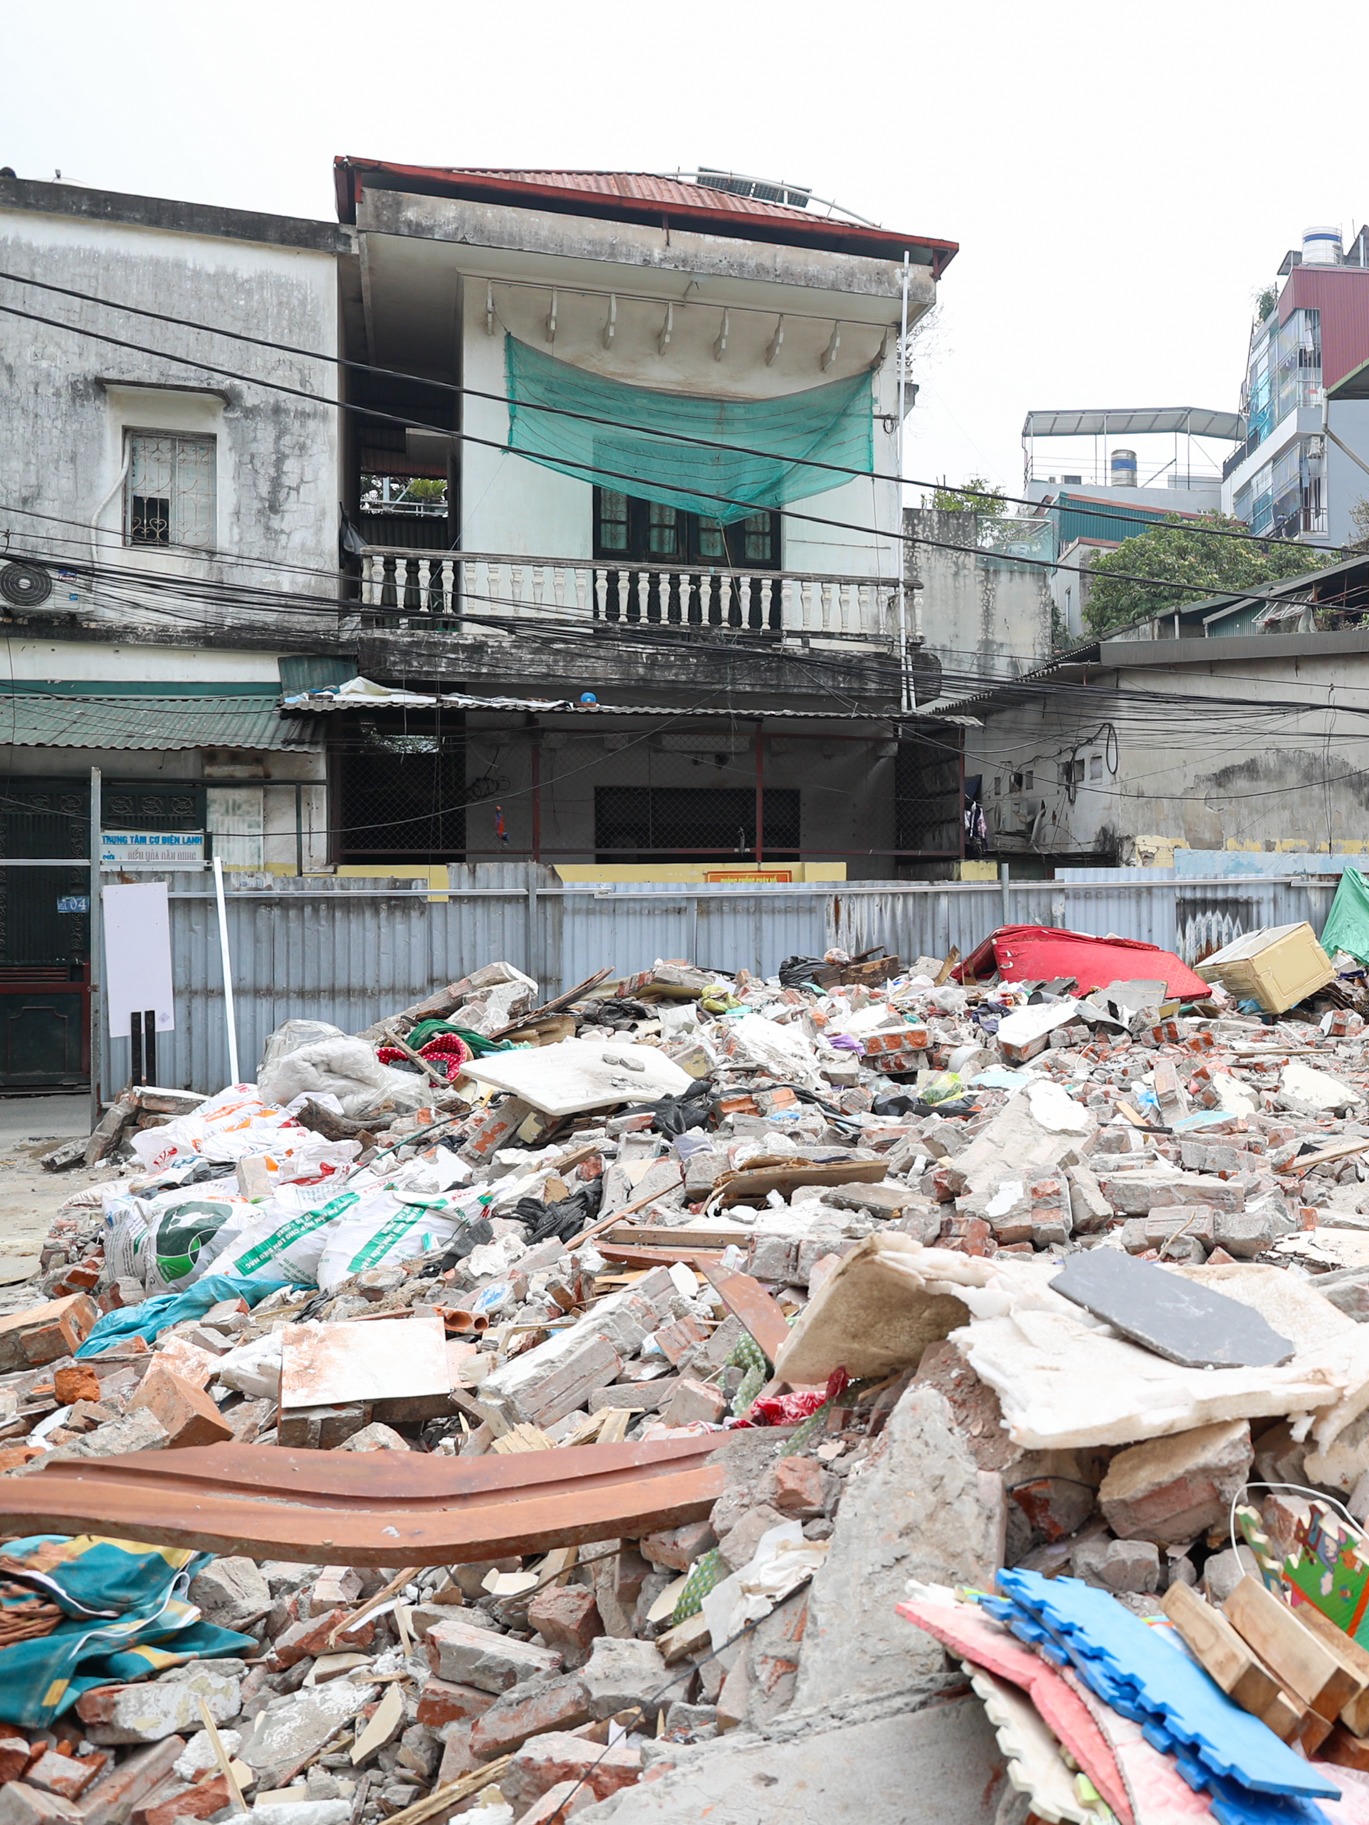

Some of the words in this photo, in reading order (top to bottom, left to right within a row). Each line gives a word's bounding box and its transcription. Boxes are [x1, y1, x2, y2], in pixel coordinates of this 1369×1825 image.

[102, 835, 128, 845] TRUNG
[129, 834, 147, 845] TÂM
[182, 835, 203, 846] LẠNH
